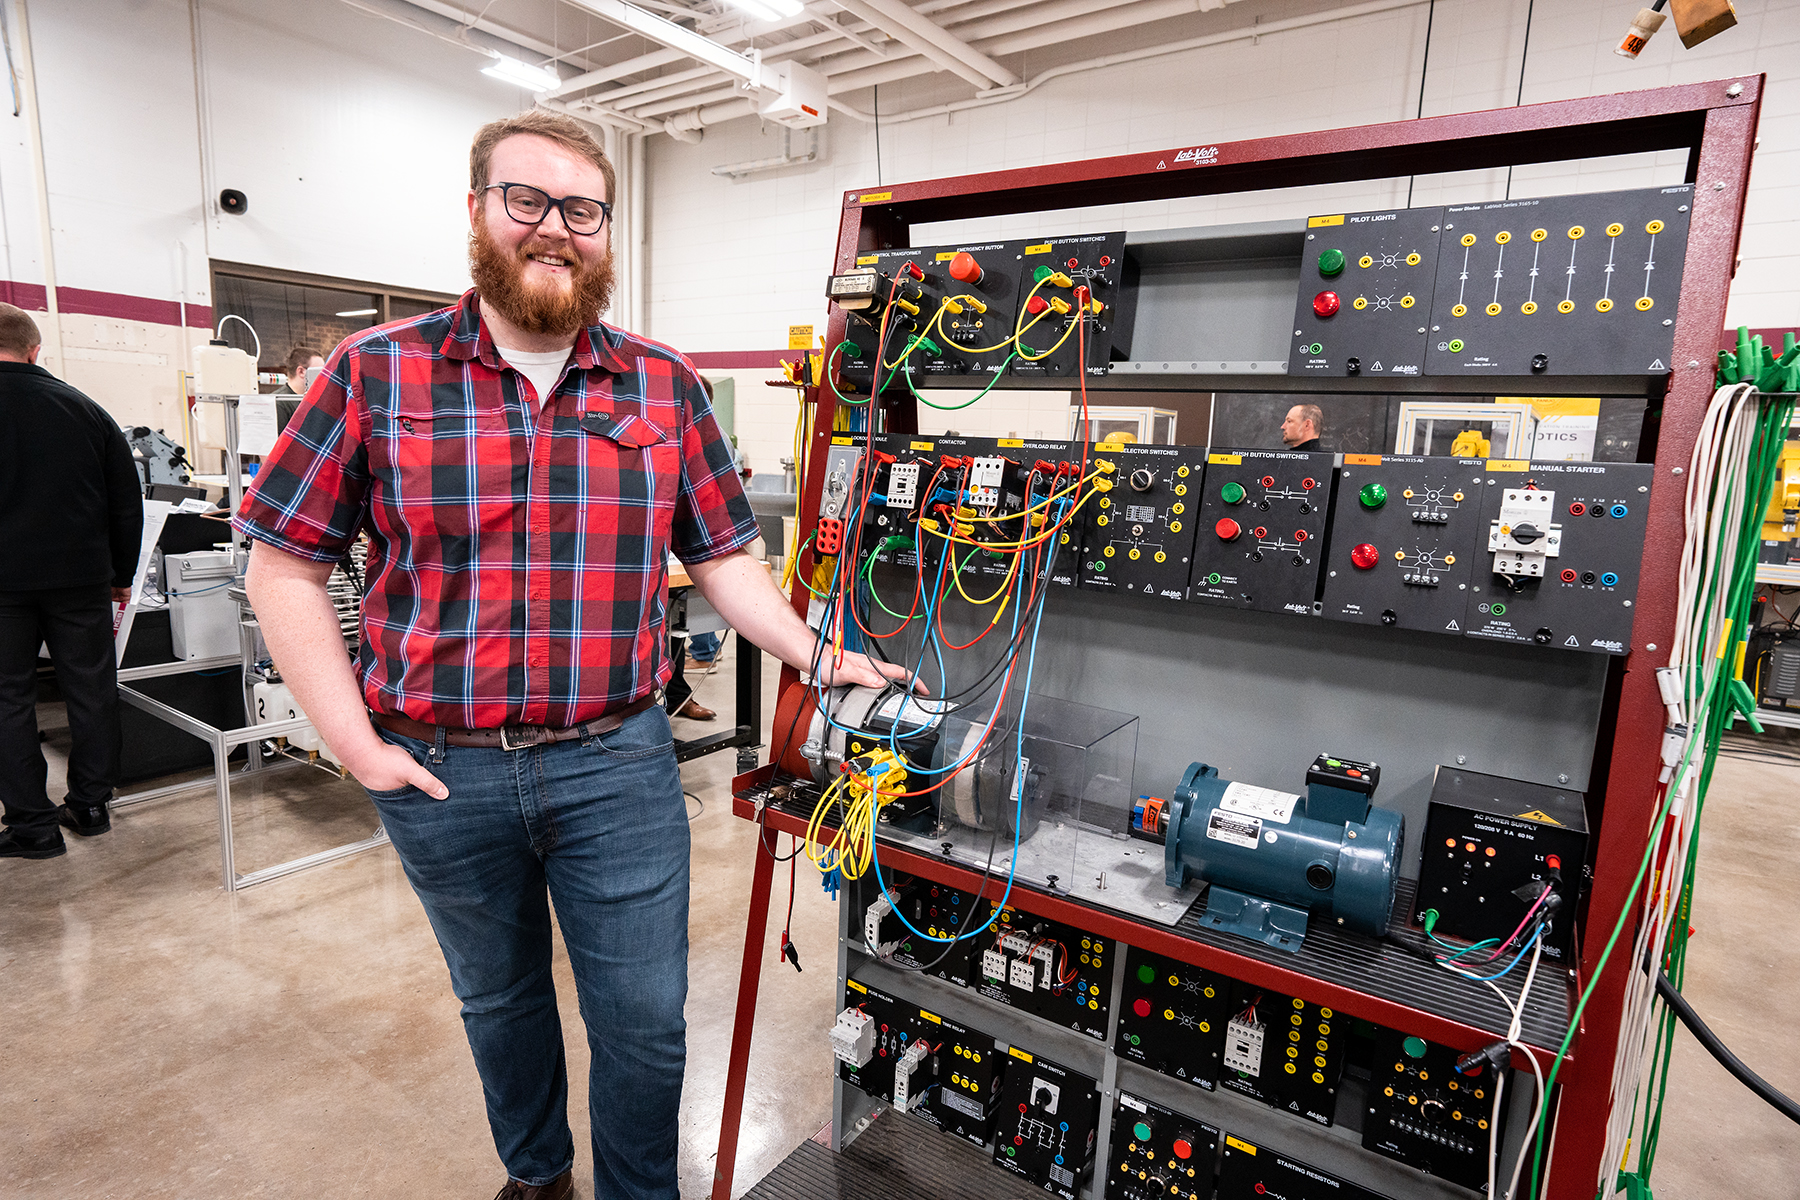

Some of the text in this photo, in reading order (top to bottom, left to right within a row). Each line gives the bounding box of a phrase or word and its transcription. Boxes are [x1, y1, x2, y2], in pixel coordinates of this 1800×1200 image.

[1530, 464, 1564, 472] MANUAL
[258, 698, 266, 720] 2
[1484, 816, 1510, 825] POWER
[1510, 820, 1538, 831] SUPPLY
[1276, 1158, 1340, 1188] STARTING RESISTORS
